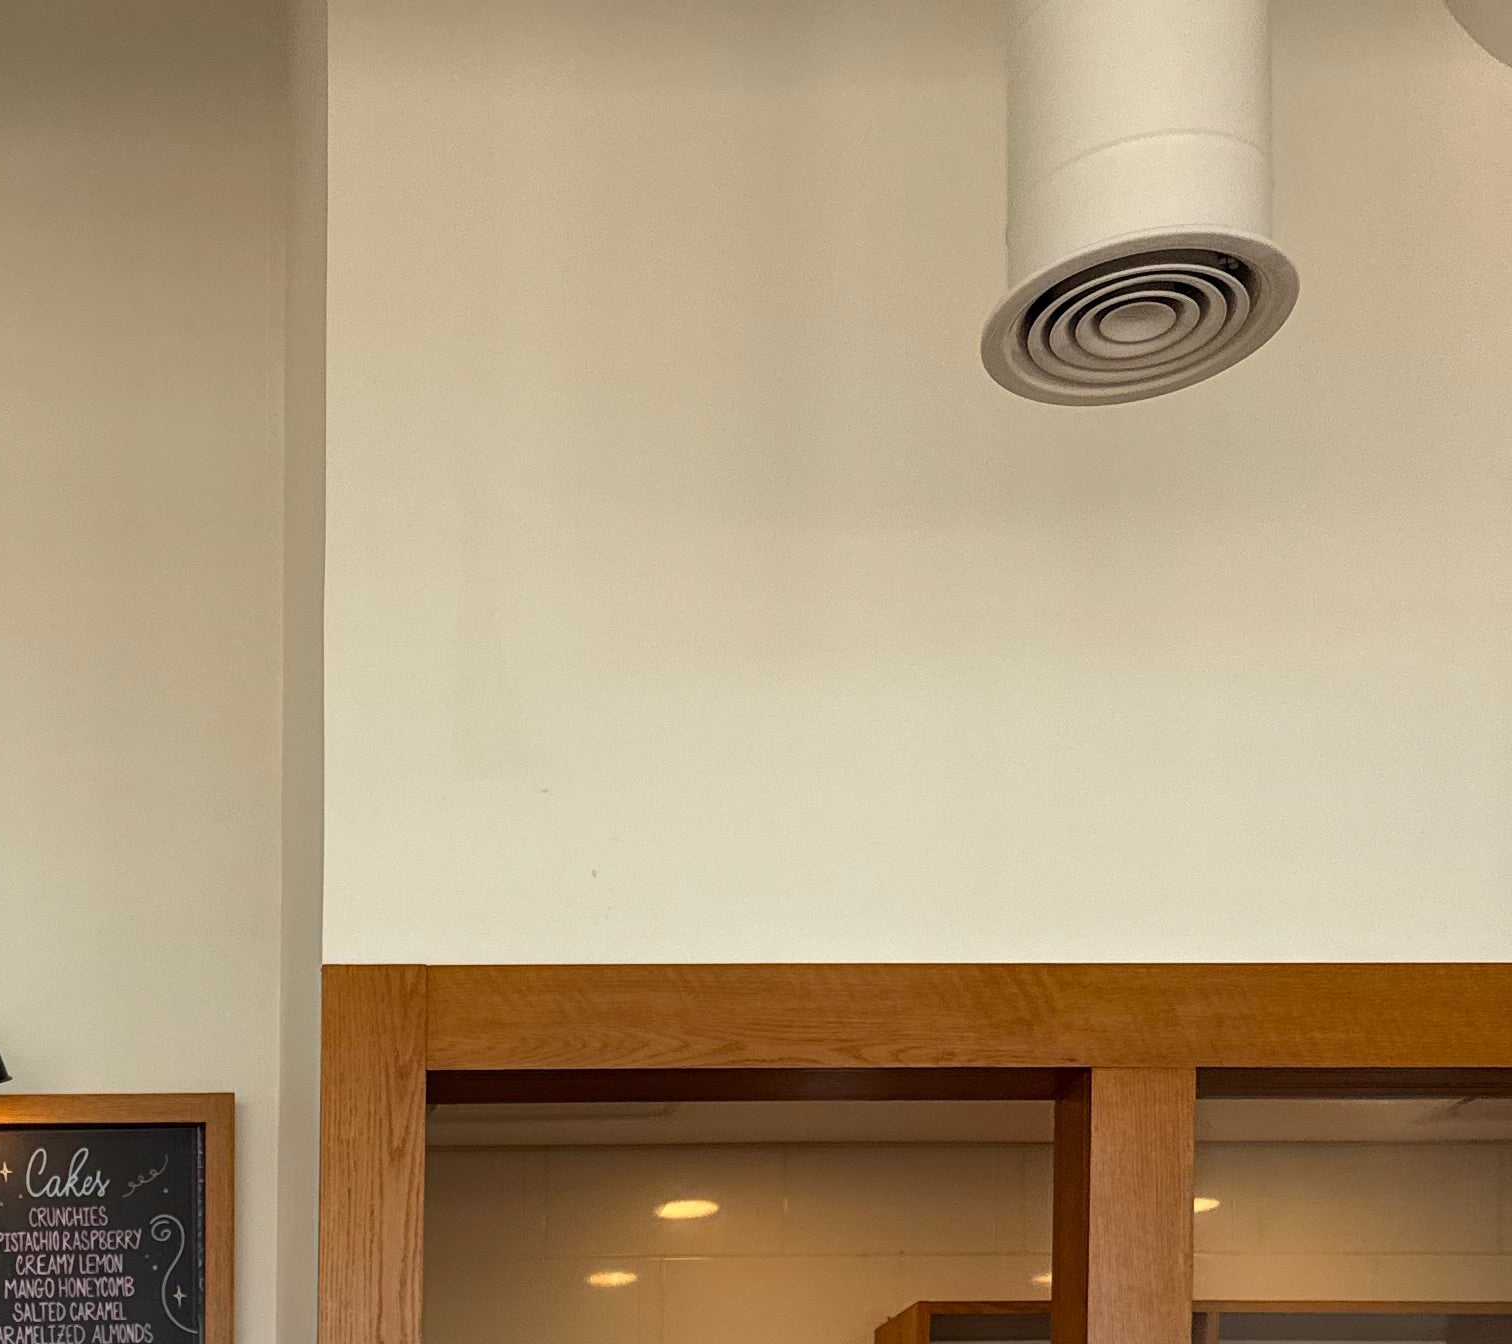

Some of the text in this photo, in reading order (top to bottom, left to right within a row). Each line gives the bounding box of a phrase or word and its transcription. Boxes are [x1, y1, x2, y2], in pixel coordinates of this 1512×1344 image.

[25, 1147, 111, 1198] Cakes
[28, 1205, 109, 1228] CRUNCHIES
[61, 1228, 143, 1252] RASPBERRY
[15, 1253, 124, 1276] CREAMY LEMON
[3, 1275, 136, 1300] MANGO HONEYCOMB
[11, 1301, 127, 1323] SALTED CARAMEL
